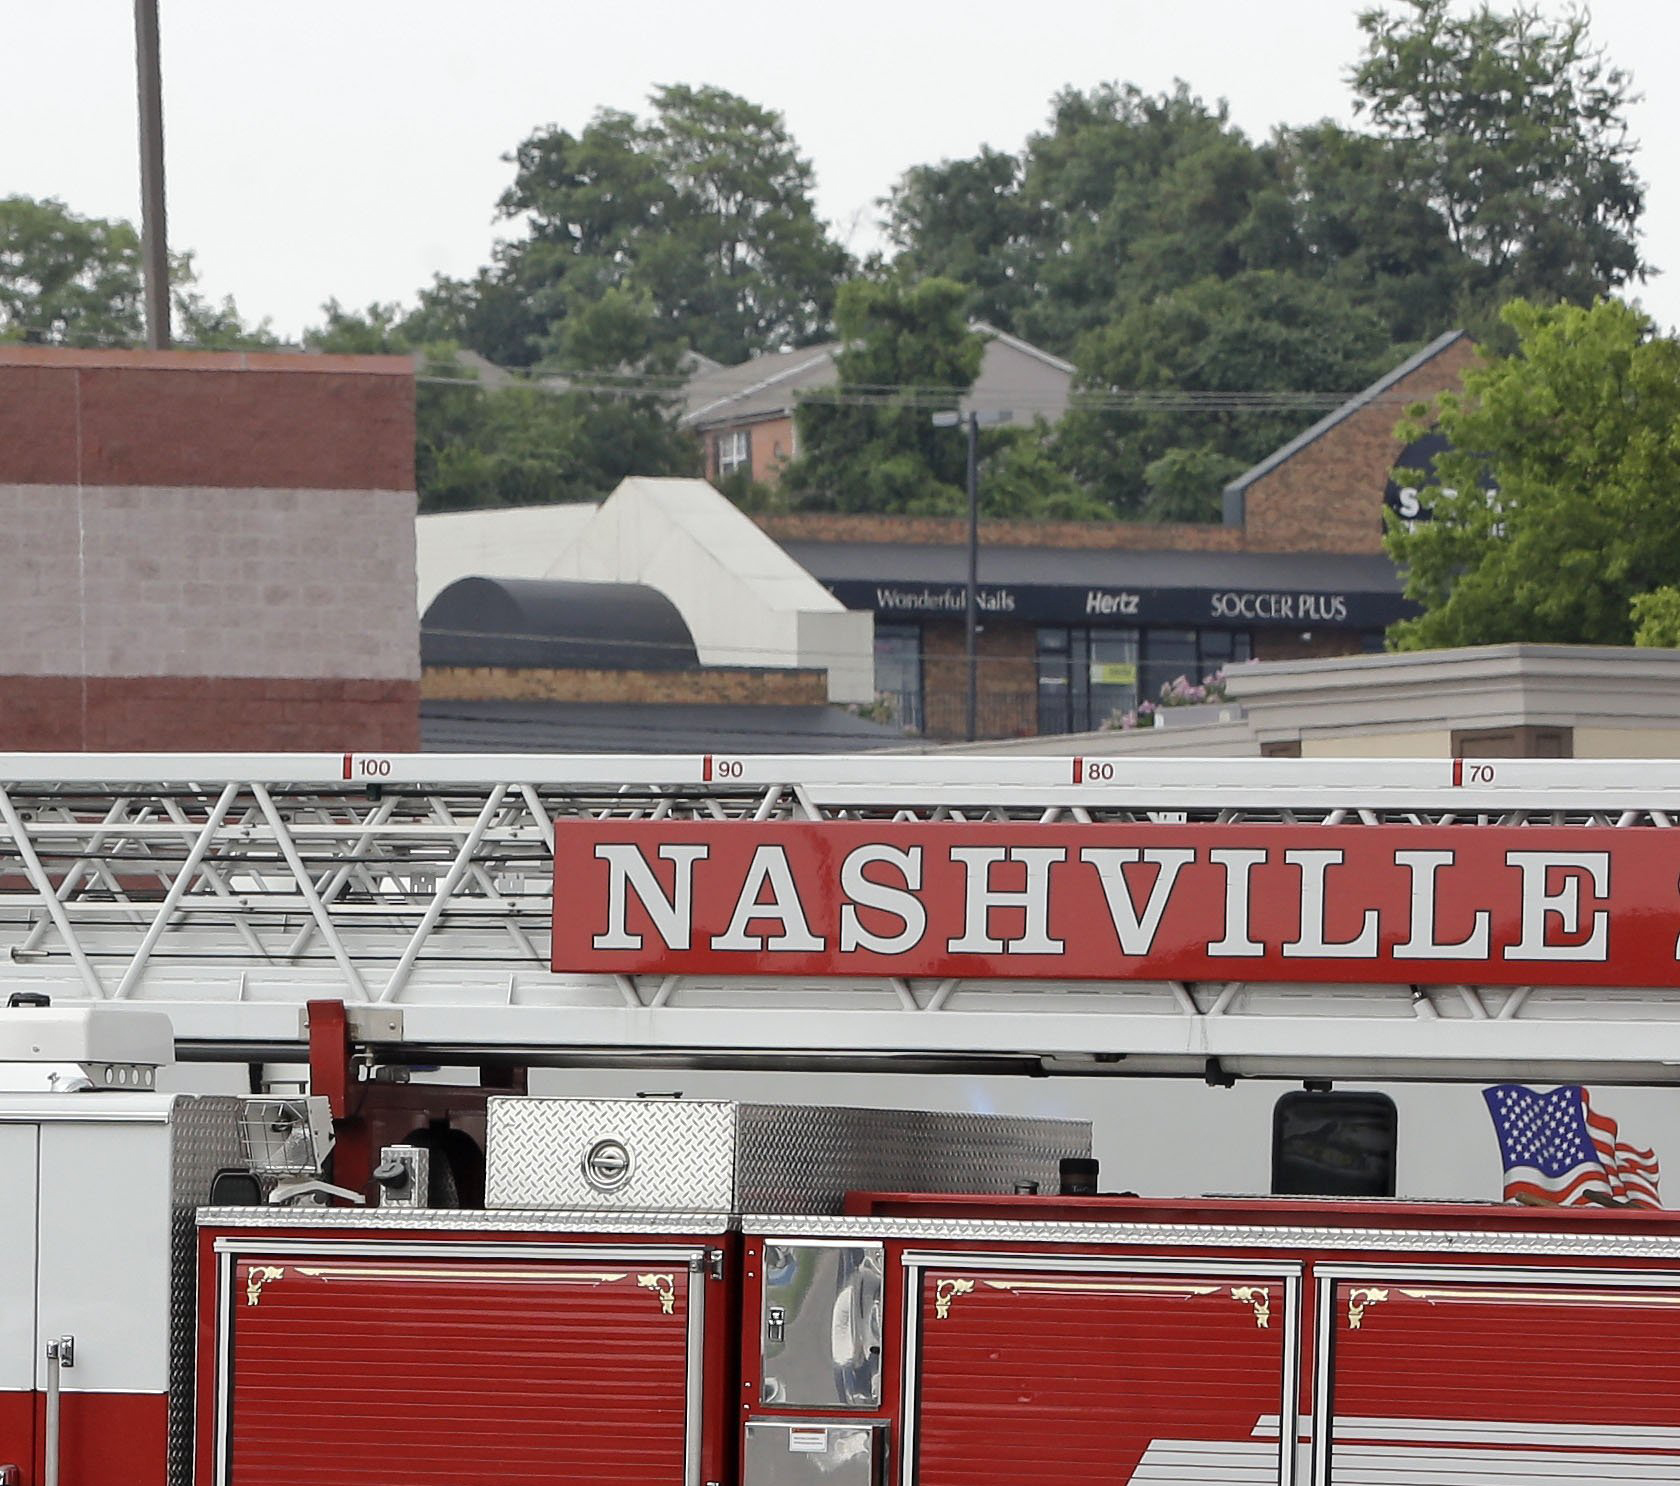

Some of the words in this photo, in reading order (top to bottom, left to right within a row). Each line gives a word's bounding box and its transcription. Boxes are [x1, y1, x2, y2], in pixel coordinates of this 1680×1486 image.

[876, 588, 966, 610] Wonderful
[1086, 591, 1140, 615] Hertz
[1210, 592, 1293, 619] SOCCER
[1298, 593, 1347, 621] PLUS
[358, 760, 392, 777] 100
[718, 761, 743, 778] 90
[1088, 763, 1114, 780] 80
[1470, 765, 1495, 783] 70
[591, 842, 1611, 962] NASHVILLE
